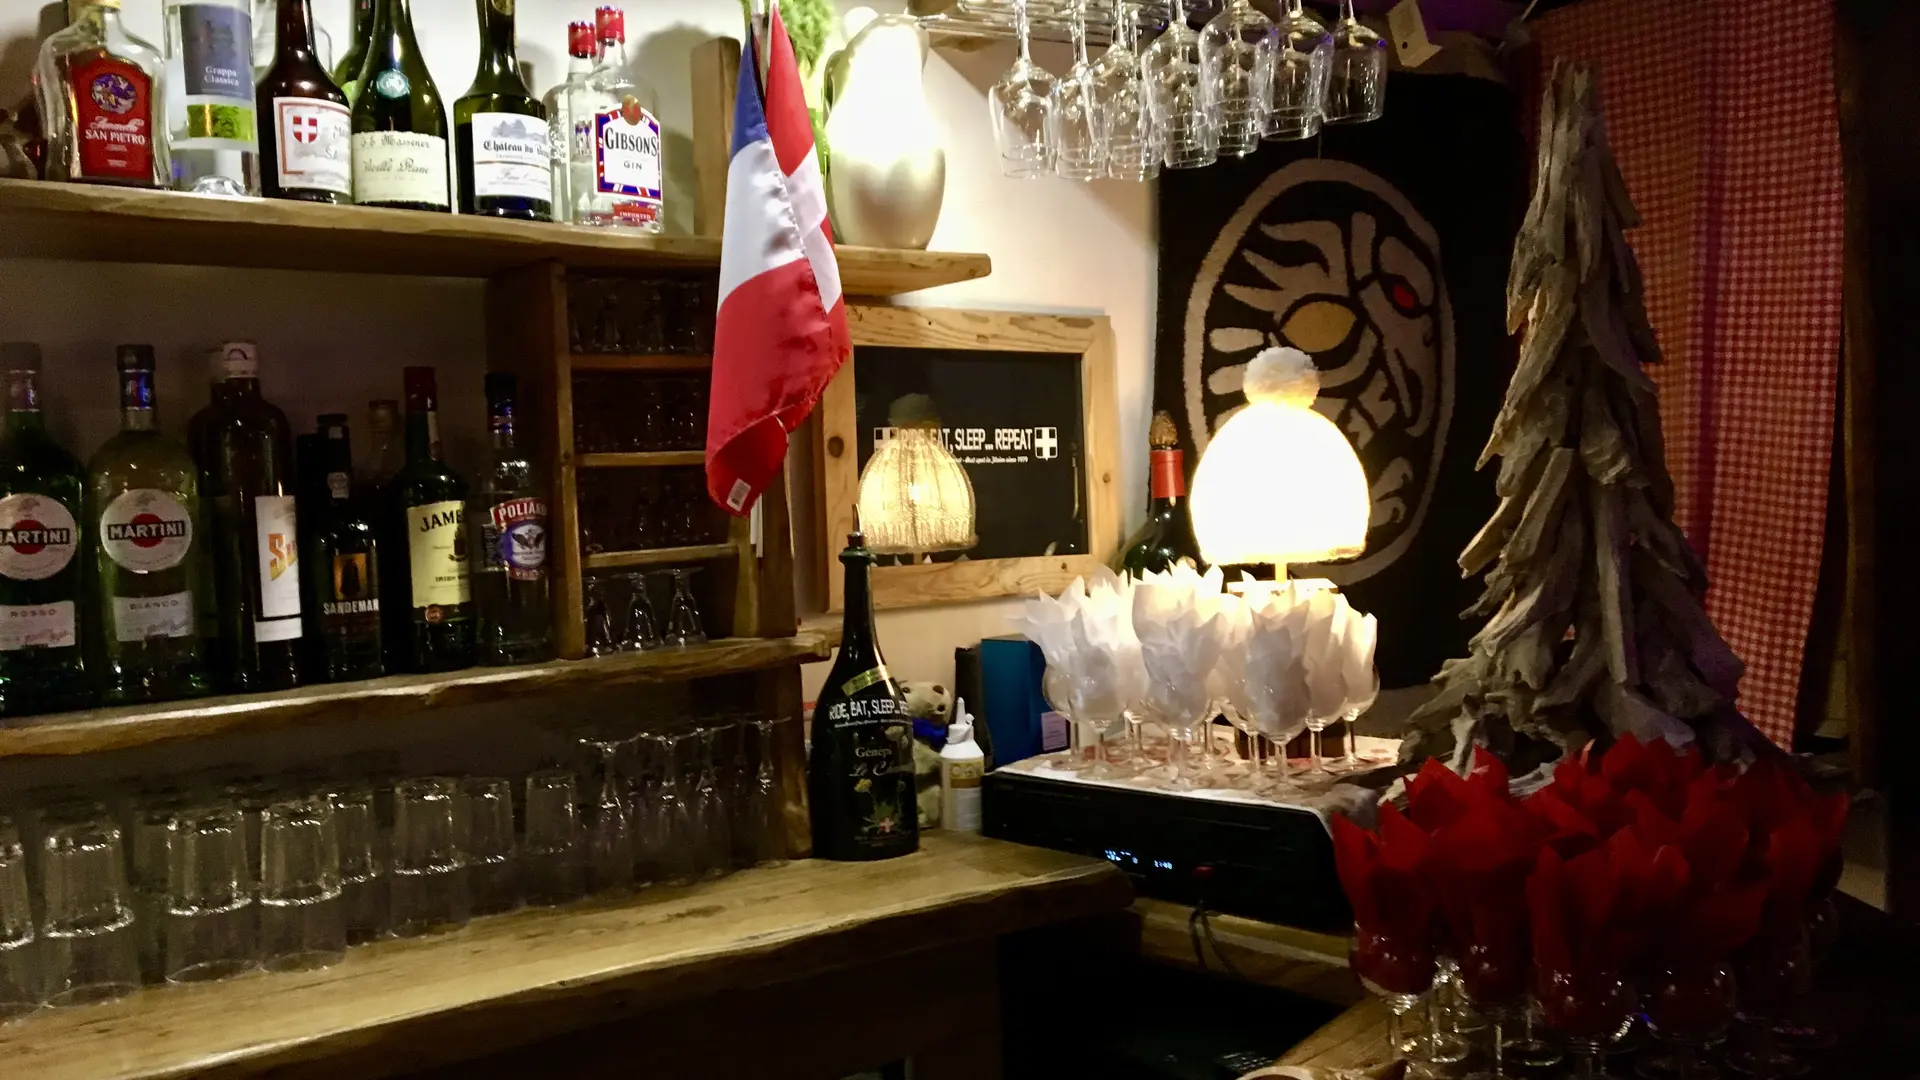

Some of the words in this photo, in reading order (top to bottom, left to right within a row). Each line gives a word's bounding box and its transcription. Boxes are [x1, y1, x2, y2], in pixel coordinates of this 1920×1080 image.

[204, 65, 238, 78] Grappa
[204, 75, 240, 87] Classica
[84, 129, 108, 141] SAN
[110, 131, 147, 146] PIETRO
[604, 126, 658, 157] GIBSONS
[623, 161, 643, 170] GIN
[618, 211, 652, 222] IMPORTED
[995, 428, 1034, 451] REPEAT
[0, 530, 69, 545] ARTINI
[110, 522, 184, 539] MARTINI
[129, 600, 179, 611] BIANCO
[323, 598, 380, 615] SANDEMAN
[10, 608, 57, 618] ROSSO
